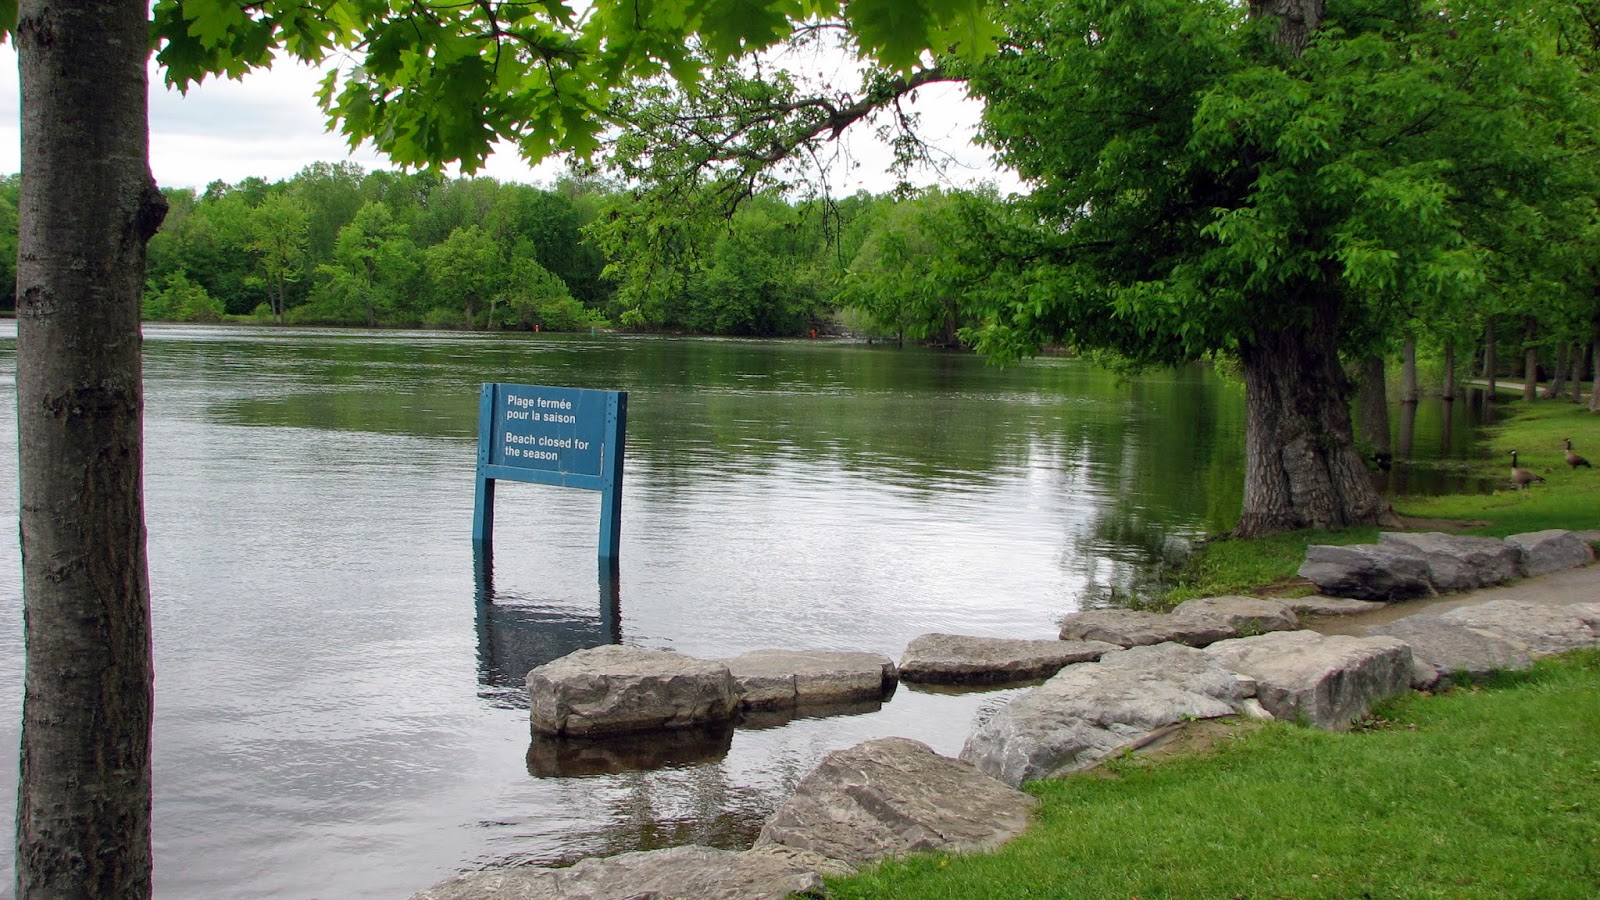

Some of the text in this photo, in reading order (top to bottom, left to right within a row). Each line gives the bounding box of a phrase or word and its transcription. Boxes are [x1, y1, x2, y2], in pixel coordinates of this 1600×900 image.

[508, 394, 572, 410] Plage fermée
[506, 410, 576, 424] pour la saison
[506, 432, 590, 450] Beach closed for
[505, 446, 558, 460] the season
